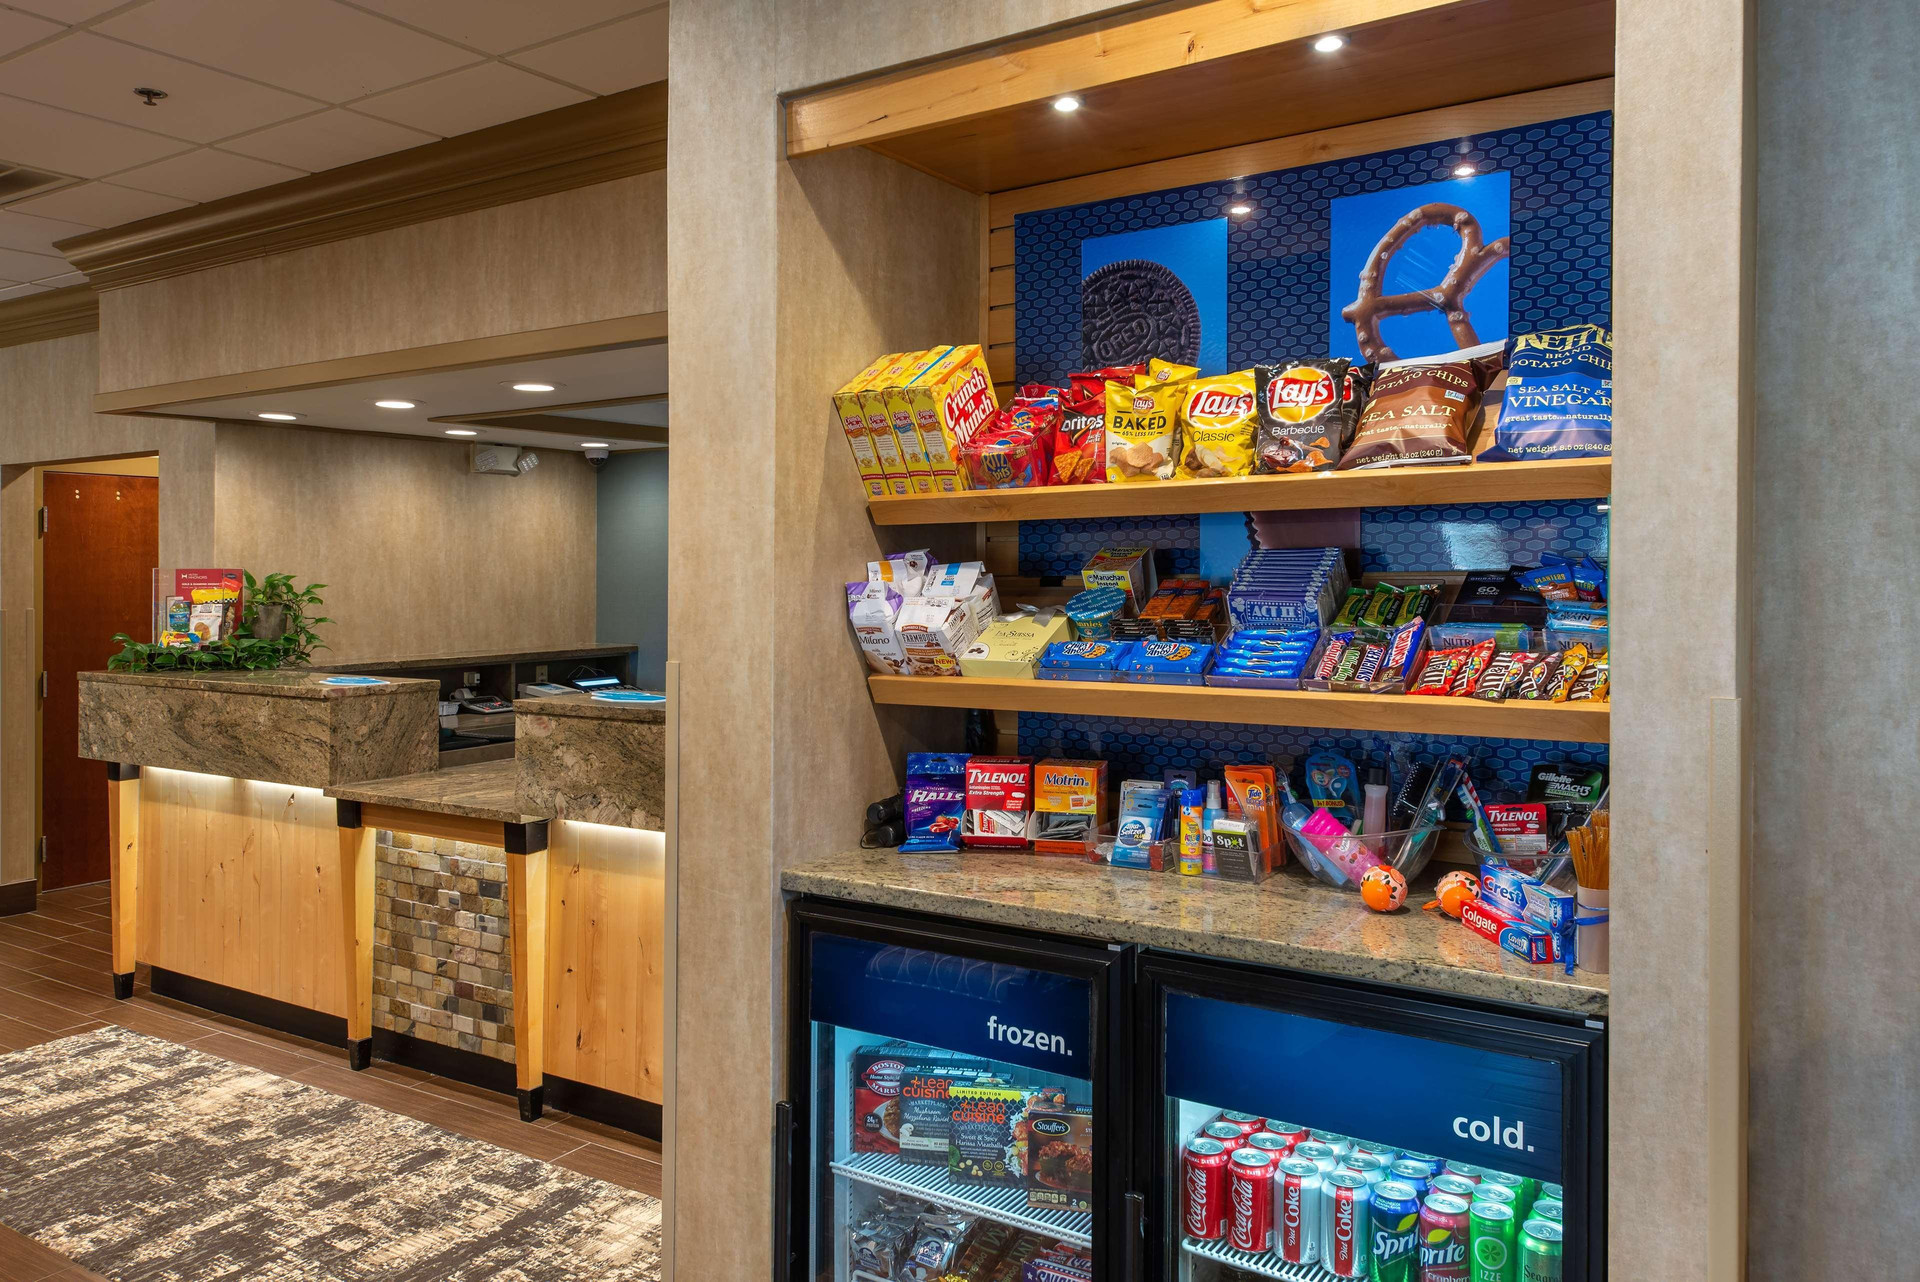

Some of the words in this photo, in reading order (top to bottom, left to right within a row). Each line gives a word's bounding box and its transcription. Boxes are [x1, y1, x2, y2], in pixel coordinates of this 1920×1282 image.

[1545, 346, 1592, 359] BRAND
[1511, 359, 1573, 368] POTATO
[1578, 354, 1612, 371] CHIP
[1427, 370, 1469, 388] CHIPS
[1273, 379, 1330, 408] Lay's
[1518, 386, 1547, 394] SEA
[1551, 383, 1590, 394] SALT
[944, 368, 987, 430] Crunch
[1134, 398, 1154, 409] Lay's
[1191, 391, 1252, 418] Lay's
[1509, 394, 1612, 407] VINEGAR
[1401, 404, 1456, 418] SALT
[1505, 414, 1530, 422] great
[954, 394, 995, 448] Munch
[1113, 416, 1167, 431] BAKED
[1192, 430, 1235, 443] Classic
[1272, 425, 1325, 437] Barbecue
[1525, 445, 1557, 453] weight
[981, 452, 1008, 468] RITZ
[1356, 455, 1371, 464] net
[1372, 452, 1399, 462] weight
[992, 466, 1012, 481] bits
[1092, 574, 1126, 582] Maruchan
[1534, 573, 1566, 584] PLANTERS
[1252, 606, 1278, 618] ACT
[859, 635, 890, 645] Milano
[902, 634, 939, 643] FARMHOUSE
[1064, 643, 1089, 652] Chips
[1147, 643, 1173, 652] Chips
[1390, 628, 1413, 668] CRUNCH
[935, 658, 956, 666] NEW!
[968, 769, 1027, 785] TYLENOL
[1044, 773, 1086, 787] Motrin
[1538, 772, 1572, 784] Gillette
[910, 789, 965, 803] HALLS
[1247, 789, 1263, 798] Tide
[1553, 782, 1591, 796] MACH3
[1488, 810, 1539, 823] TYLENOL
[1484, 875, 1522, 906] Crest
[1462, 905, 1498, 934] Colgate
[987, 1016, 1073, 1056] frozen.
[871, 1083, 900, 1094] MARK
[970, 1101, 1005, 1114] Lean
[1036, 1121, 1067, 1133] Stouffer's
[1453, 1116, 1534, 1152] cold.
[955, 1138, 975, 1147] Harissa
[1187, 1163, 1207, 1236] Coca-Cola
[1231, 1175, 1253, 1249] Coca-Cola
[1284, 1186, 1300, 1228] Coke
[1335, 1199, 1352, 1242] Coke
[1287, 1227, 1296, 1247] Diet
[1338, 1241, 1348, 1261] Diet
[1420, 1232, 1465, 1268] prite
[1480, 1269, 1501, 1281] IZZE
